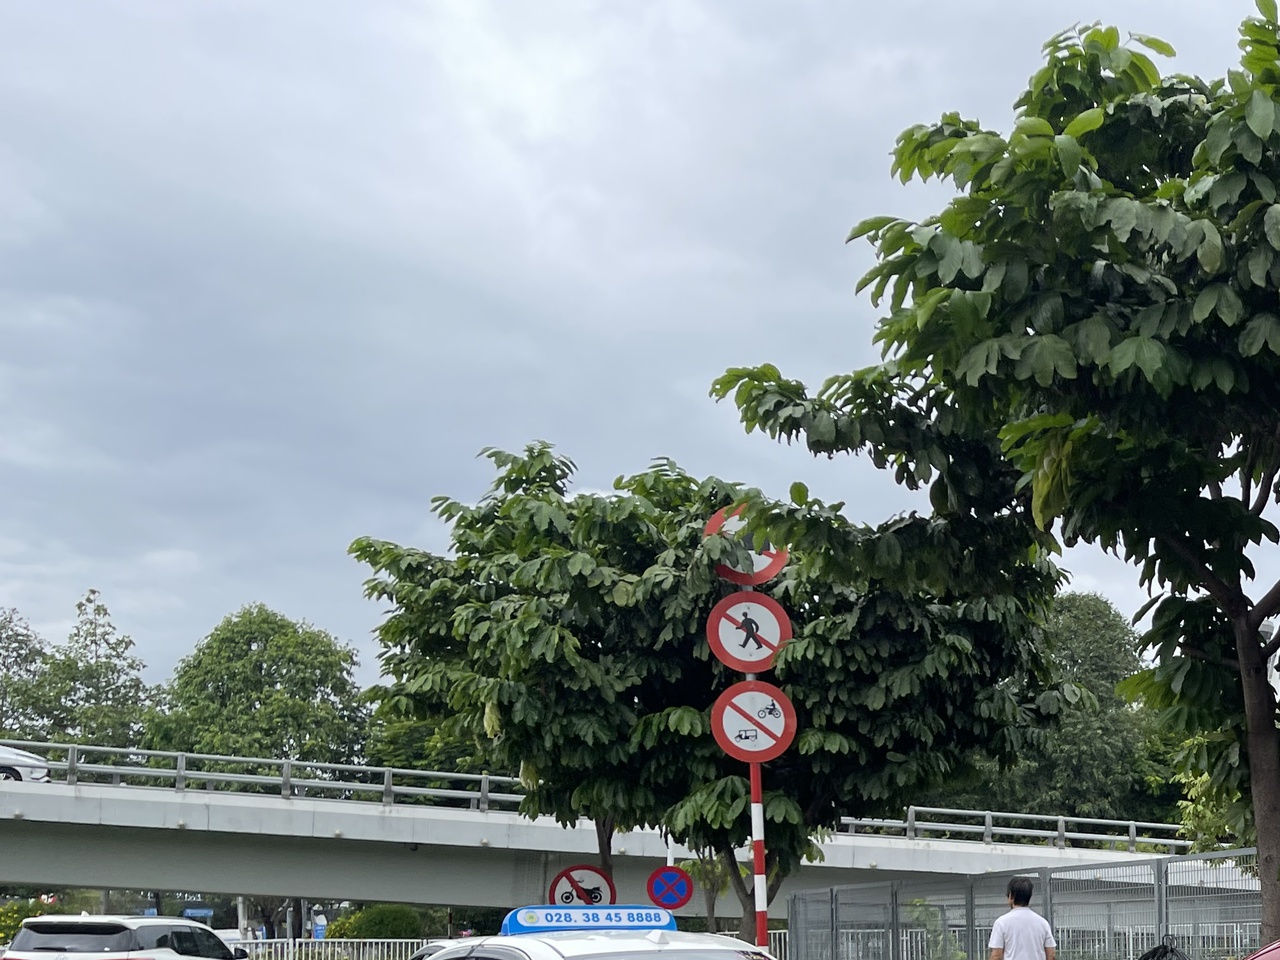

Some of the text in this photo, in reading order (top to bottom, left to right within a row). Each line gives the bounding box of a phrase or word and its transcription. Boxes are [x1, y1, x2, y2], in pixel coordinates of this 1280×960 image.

[544, 912, 662, 923] 028. 38 45 8888
